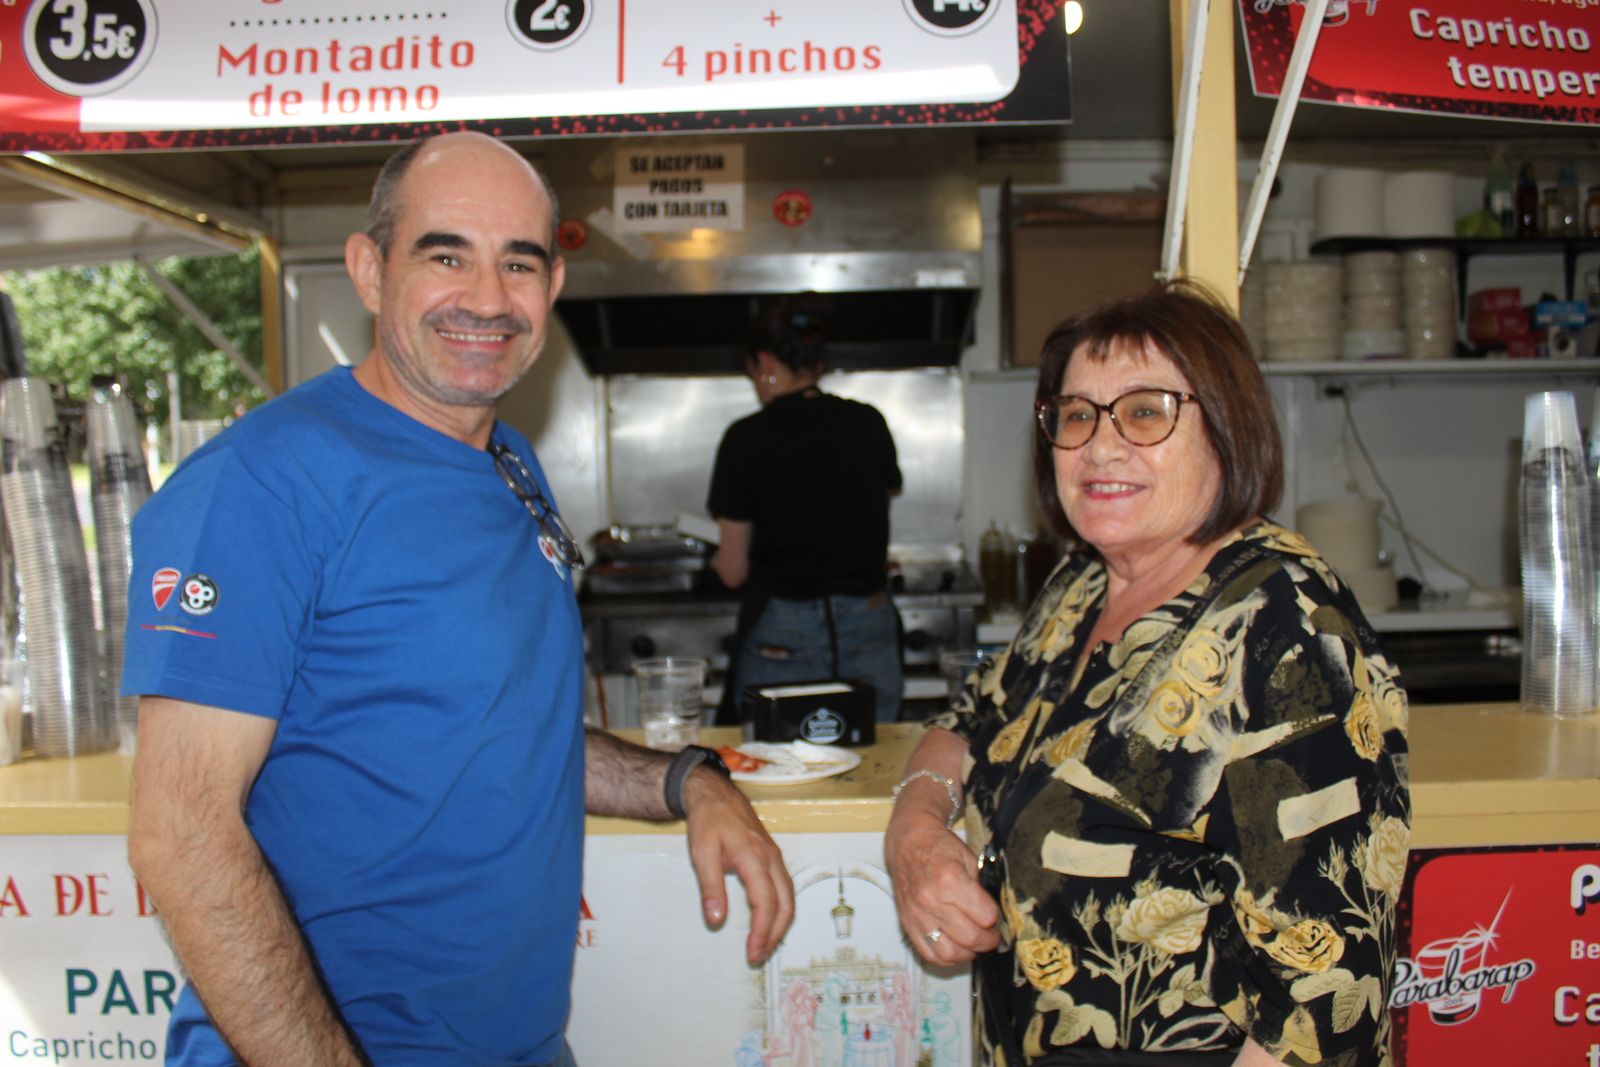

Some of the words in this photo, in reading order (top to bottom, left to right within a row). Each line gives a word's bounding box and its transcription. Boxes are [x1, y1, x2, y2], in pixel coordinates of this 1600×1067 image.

[1409, 9, 1591, 50] Capricho
[217, 34, 475, 78] Montadito
[661, 45, 687, 76] 4
[705, 40, 882, 81] pinchos
[1447, 56, 1600, 97] temper
[248, 84, 303, 117] de
[321, 81, 439, 114] lomo
[630, 156, 648, 173] SE
[652, 154, 724, 172] ACEPTAN
[649, 179, 703, 194] PAGOS
[624, 202, 657, 219] CON
[664, 200, 729, 217] TARJETA
[53, 873, 113, 917] DE
[65, 968, 176, 1015] PAR
[9, 1030, 157, 1064] Capricho
